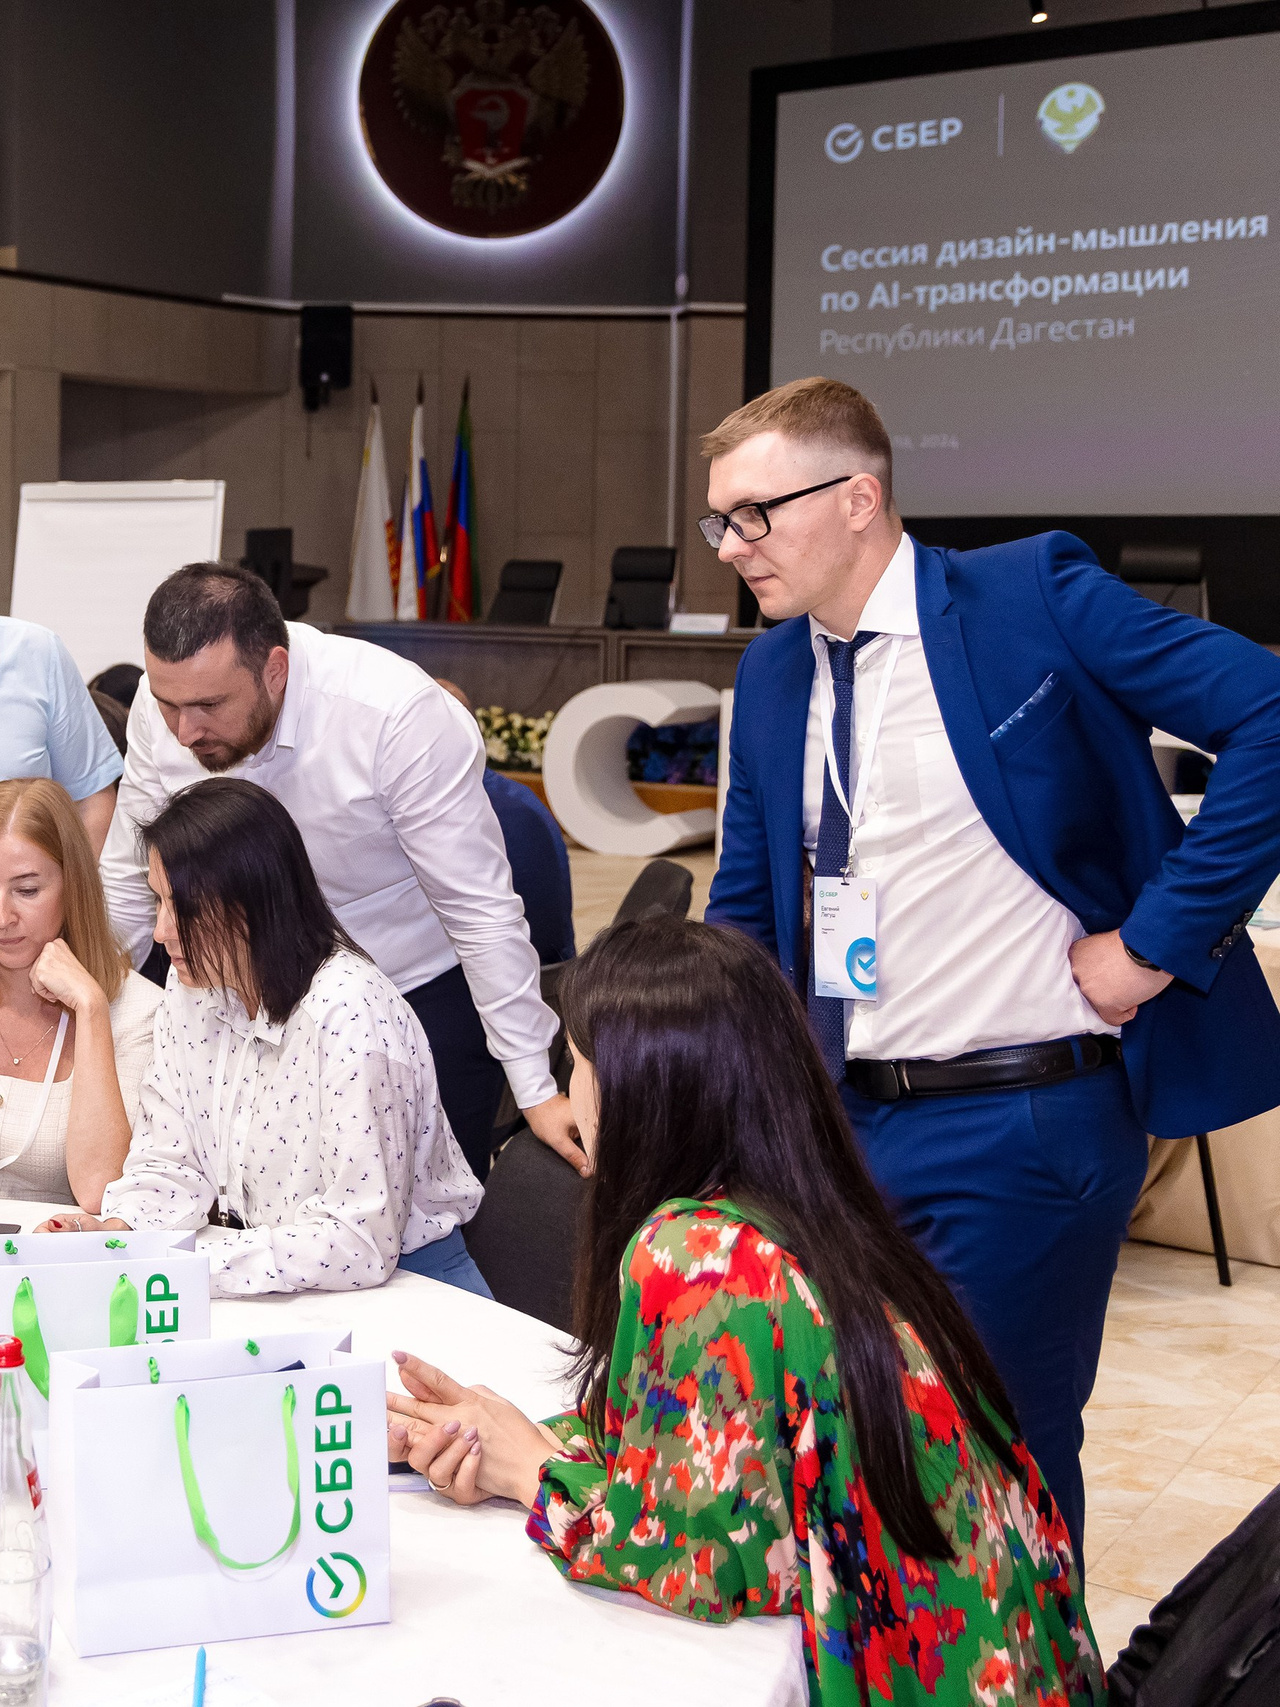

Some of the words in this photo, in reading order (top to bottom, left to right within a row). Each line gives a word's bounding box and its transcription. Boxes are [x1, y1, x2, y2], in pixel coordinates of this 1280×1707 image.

[871, 117, 963, 152] СБЕР
[821, 241, 928, 272] Сессия
[935, 214, 1268, 268] дизайн-мышления
[821, 290, 859, 312] по
[868, 266, 1189, 312] AI-трансформации
[820, 323, 985, 358] Республики
[989, 316, 1135, 351] Дагестан
[145, 1272, 179, 1343] ЕР
[314, 1383, 354, 1534] СБЕР
